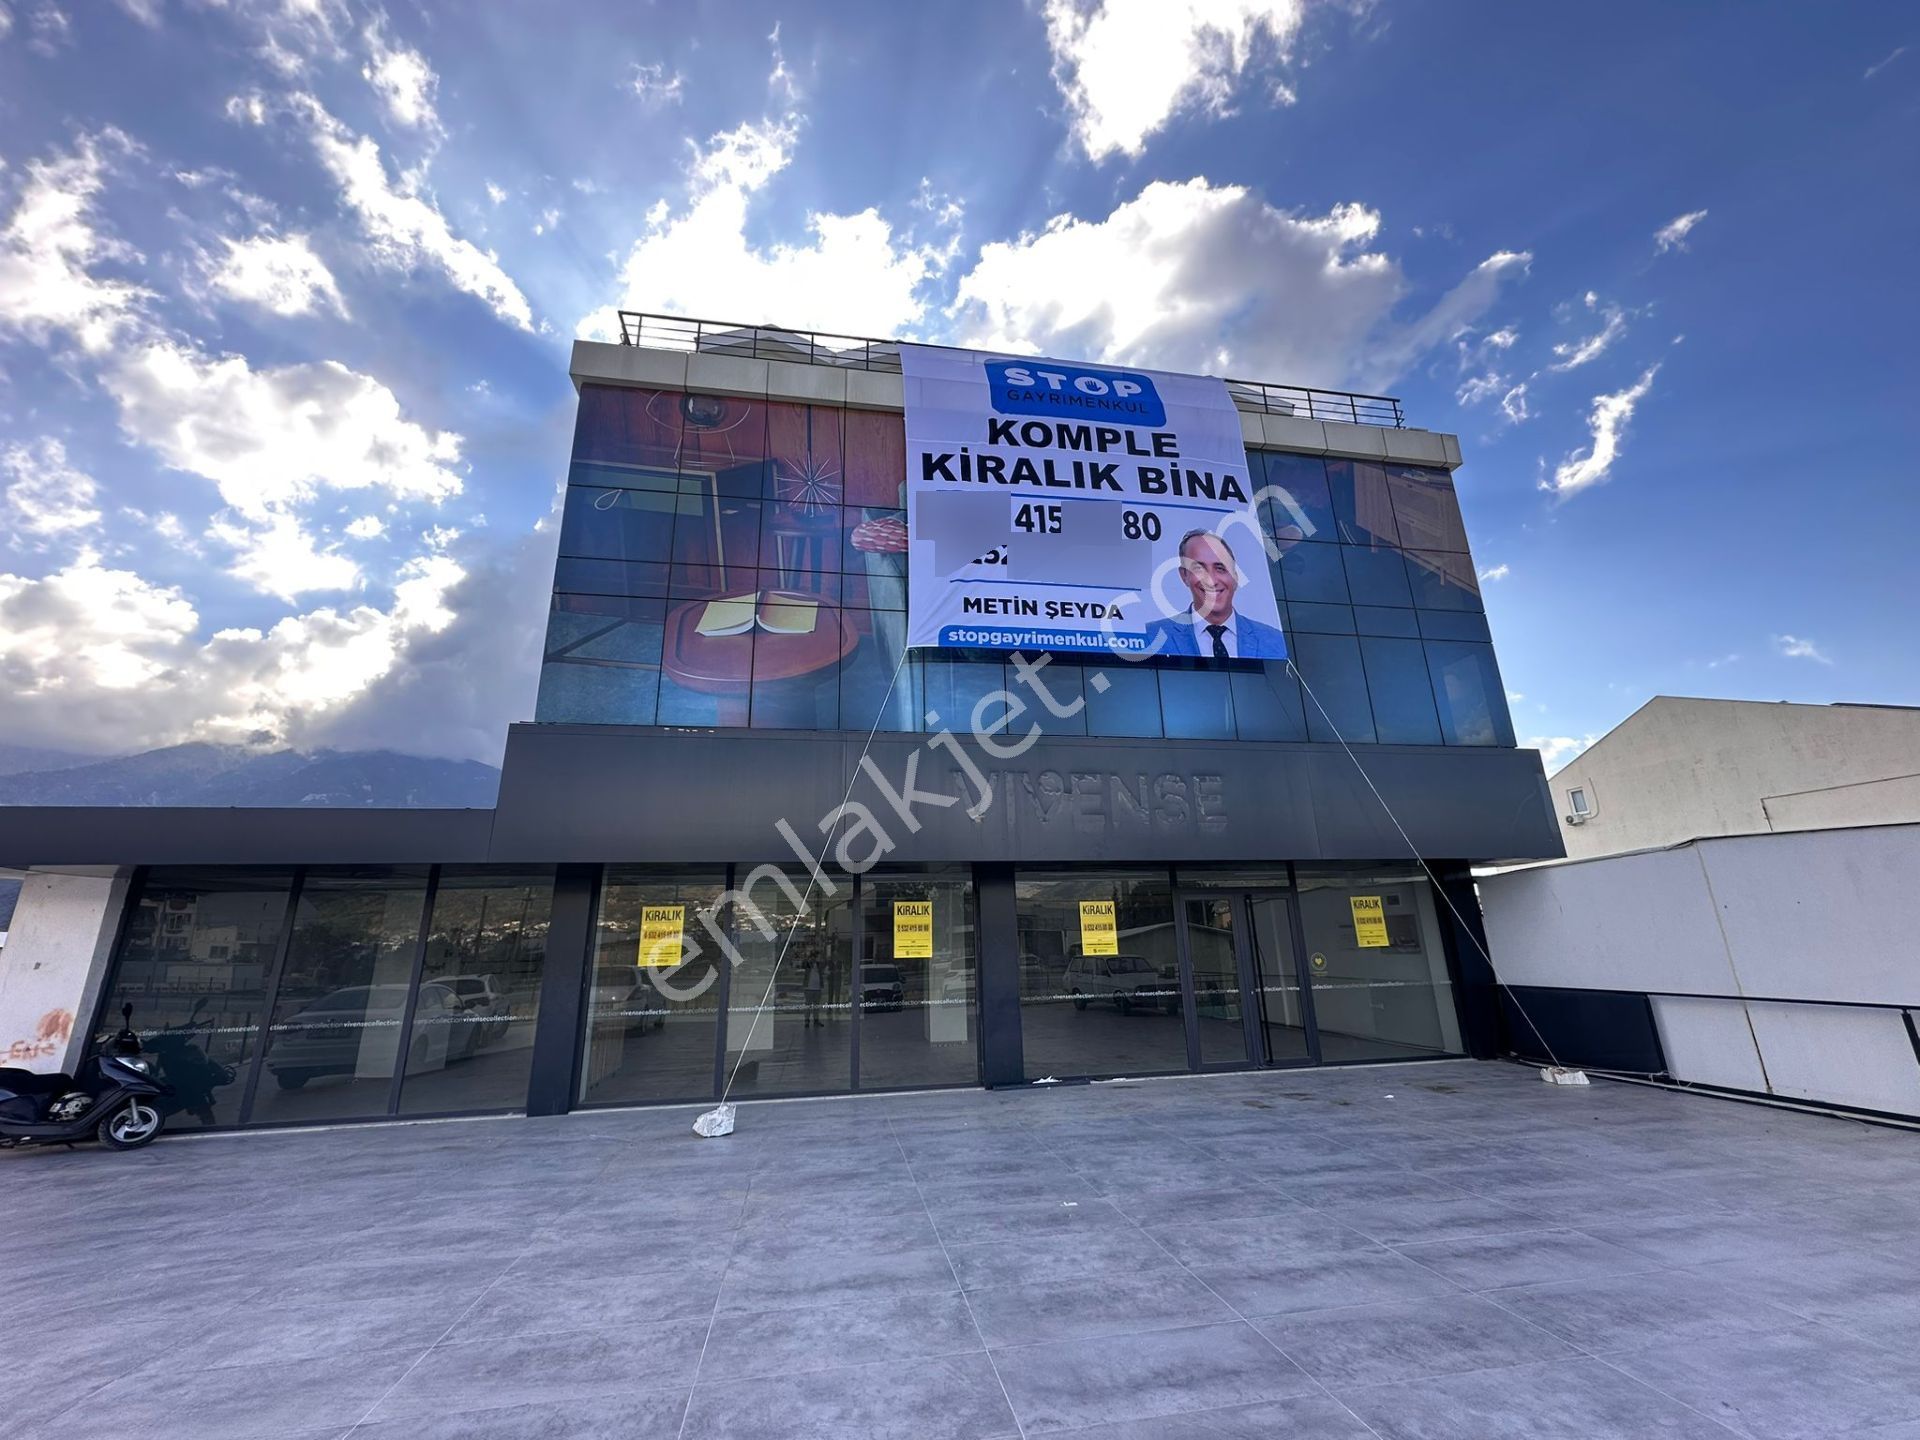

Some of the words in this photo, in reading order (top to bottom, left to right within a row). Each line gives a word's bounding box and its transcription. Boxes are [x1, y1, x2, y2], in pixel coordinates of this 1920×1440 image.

[1004, 367, 1142, 398] STOP
[988, 418, 1180, 459] KOMPLE
[921, 446, 1124, 492] KİRALIK
[1137, 461, 1248, 504] BİNA
[1014, 504, 1062, 533] 415
[1122, 510, 1162, 541] 80
[963, 595, 1039, 616] METİN
[1044, 600, 1125, 620] ŞEYDA
[948, 629, 1146, 650] stopgayrimenkul.com
[950, 768, 1228, 829] VIVENSE
